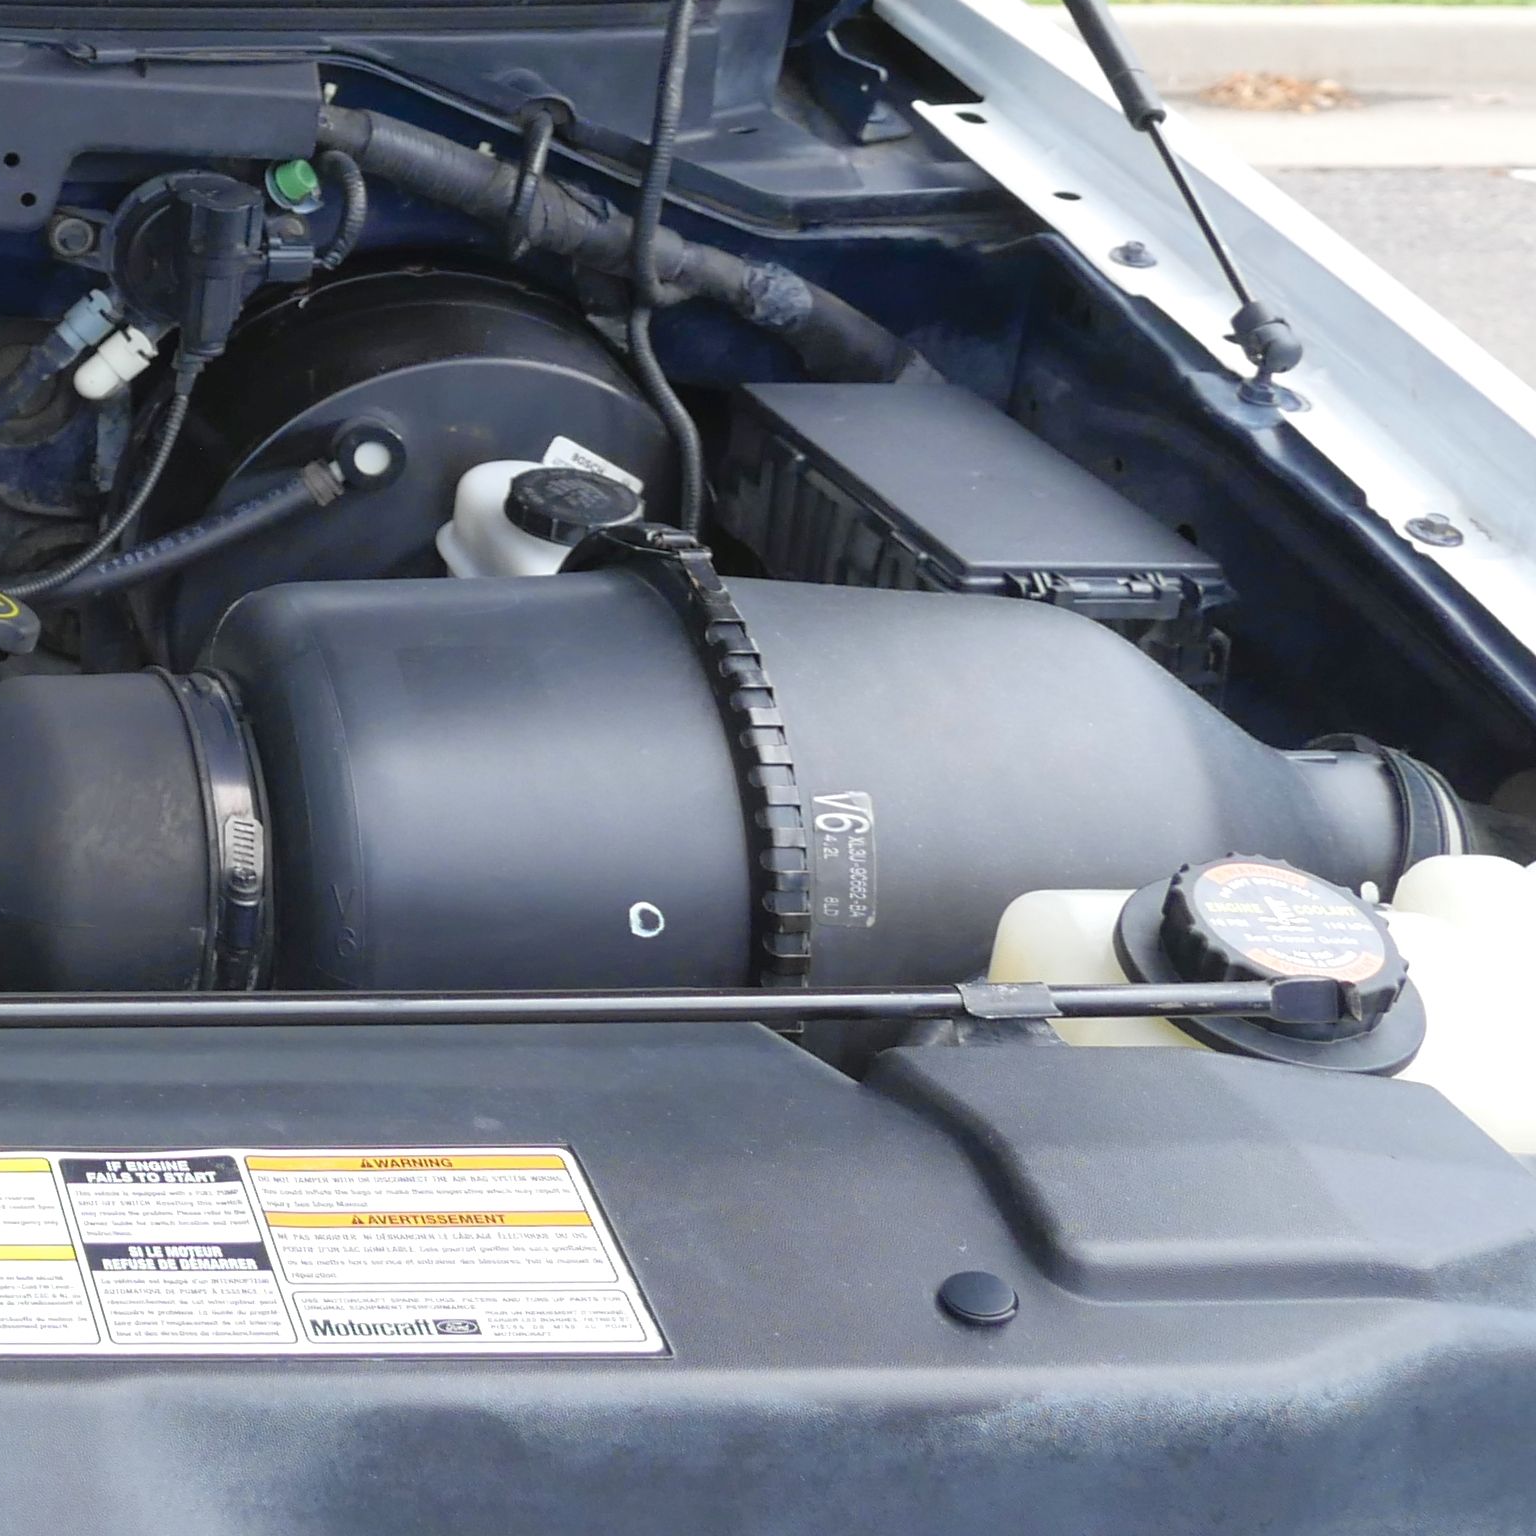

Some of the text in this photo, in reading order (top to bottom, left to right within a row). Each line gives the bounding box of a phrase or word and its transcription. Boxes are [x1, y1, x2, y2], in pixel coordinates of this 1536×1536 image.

[813, 791, 870, 833] V6
[106, 1161, 190, 1171] IF ENGINE
[372, 1158, 453, 1168] WARNING
[86, 1172, 217, 1183] FAILS TO START
[368, 1214, 506, 1225] AVERTISSEMENT
[128, 1246, 223, 1258] SI LE MOTEUR
[102, 1259, 156, 1270] REFUSE
[158, 1259, 178, 1270] DE
[309, 1318, 434, 1337] Motorcraft
